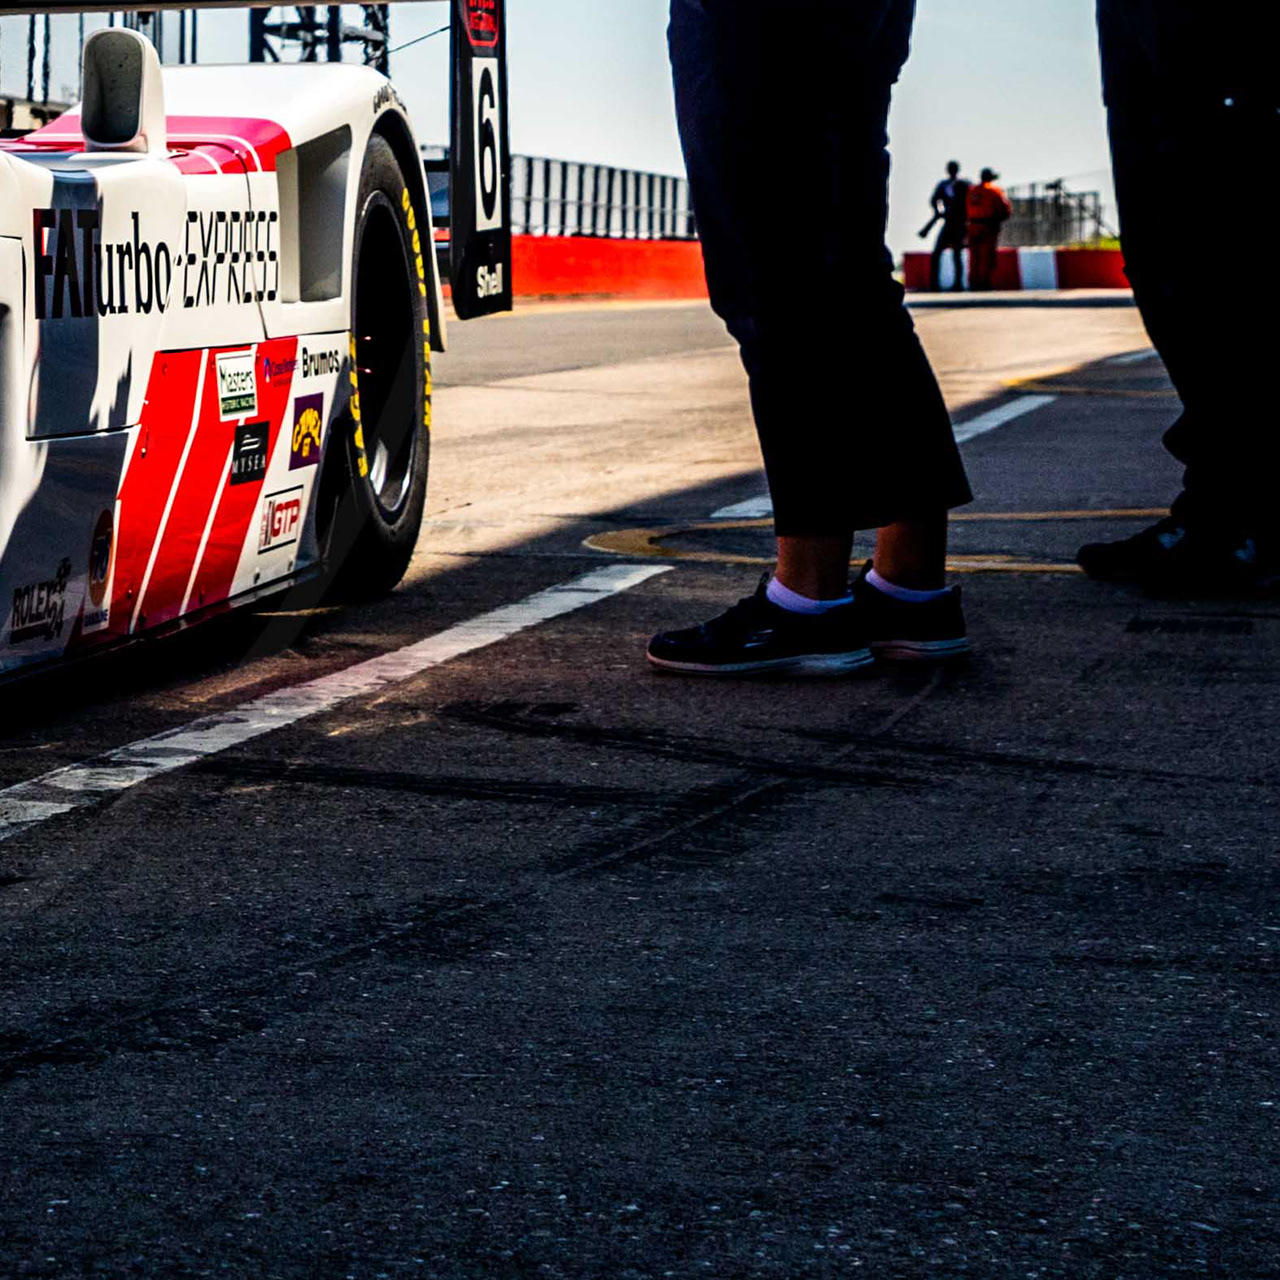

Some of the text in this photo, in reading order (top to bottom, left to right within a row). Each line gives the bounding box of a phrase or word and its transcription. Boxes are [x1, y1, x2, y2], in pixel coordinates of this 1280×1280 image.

[477, 66, 497, 221] 6
[476, 262, 503, 299] Shell
[301, 346, 341, 379] Brumos
[271, 497, 301, 538] GTP
